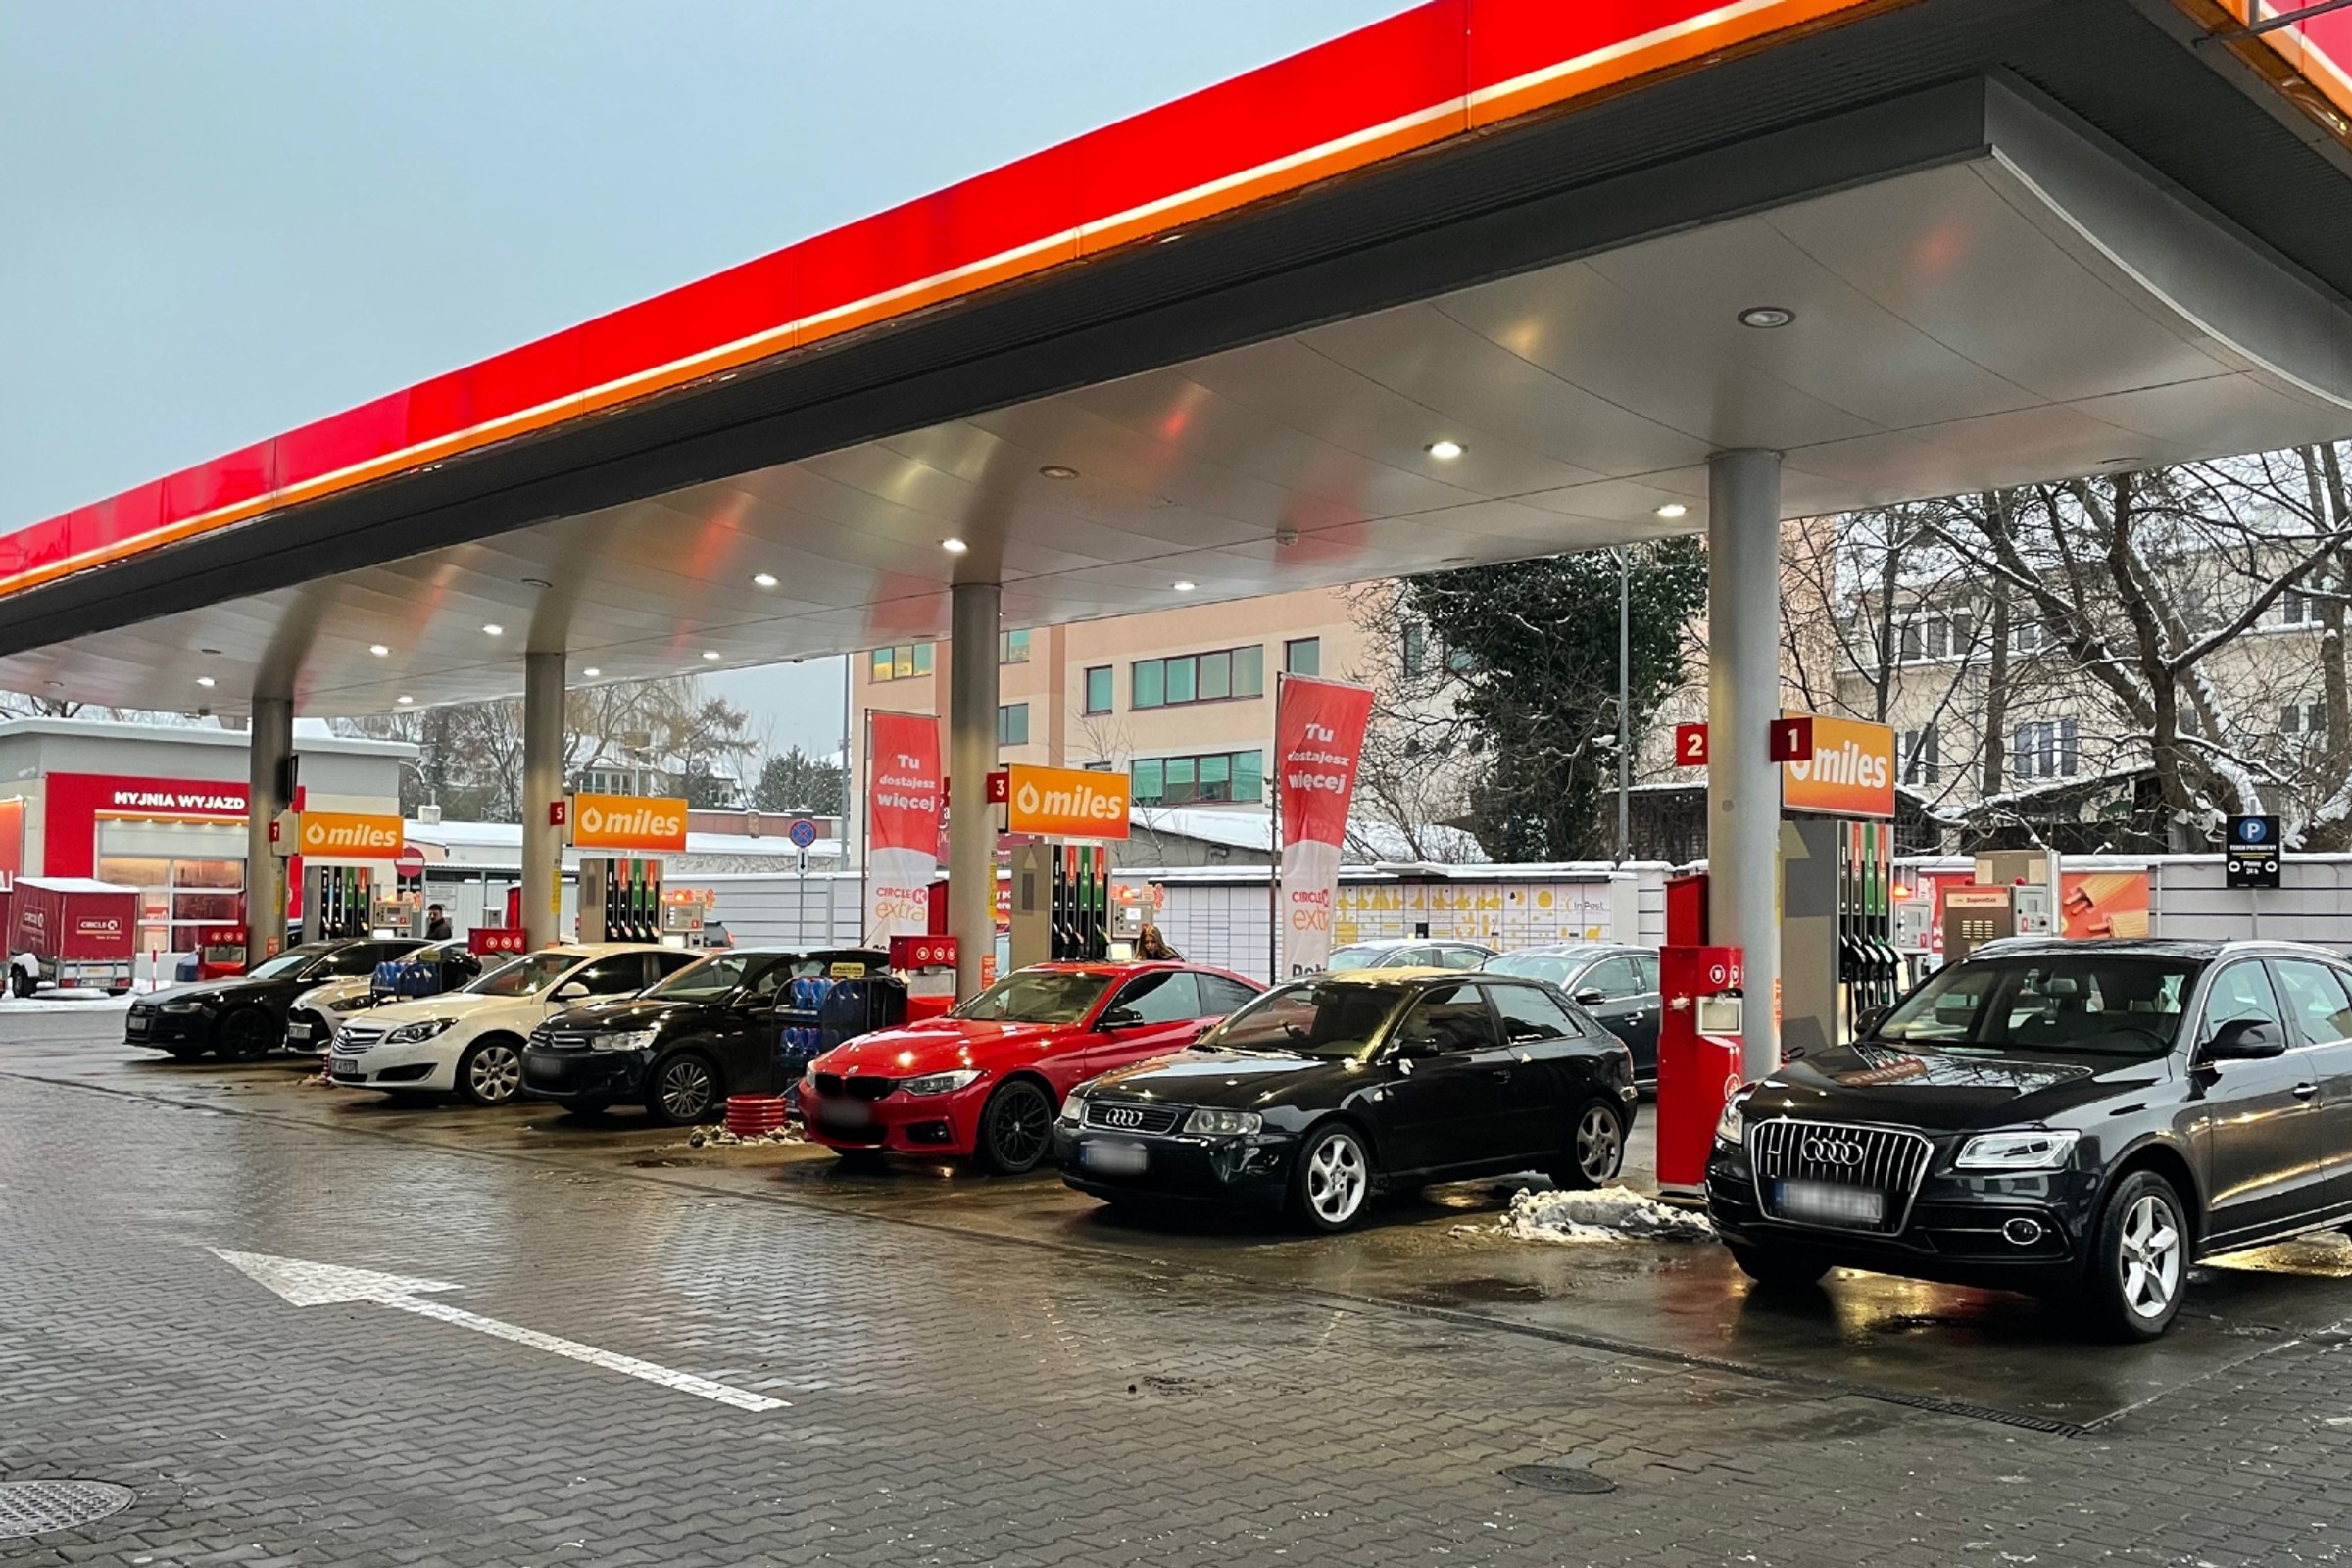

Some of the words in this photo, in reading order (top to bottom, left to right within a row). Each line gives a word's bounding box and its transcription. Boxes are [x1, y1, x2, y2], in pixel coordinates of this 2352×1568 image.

[1305, 723, 1334, 742] Tu
[1788, 728, 1798, 752] 1
[1687, 734, 1703, 757] 2
[898, 754, 920, 770] Tu
[1287, 751, 1350, 766] dostajesz
[1813, 739, 1887, 789] miles
[879, 774, 935, 789] dostajesz
[996, 779, 1004, 796] 3
[1288, 770, 1347, 794] więcej
[114, 792, 174, 807] MYJNIA
[177, 795, 245, 809] WYJAZD
[877, 792, 935, 812] więcej
[1042, 784, 1122, 820] miles
[556, 807, 563, 819] 5
[605, 808, 680, 836] miles
[327, 823, 398, 847] miles
[2247, 822, 2260, 839] P
[875, 887, 911, 899] CIRCLE
[914, 890, 926, 903] K
[875, 900, 926, 922] extra
